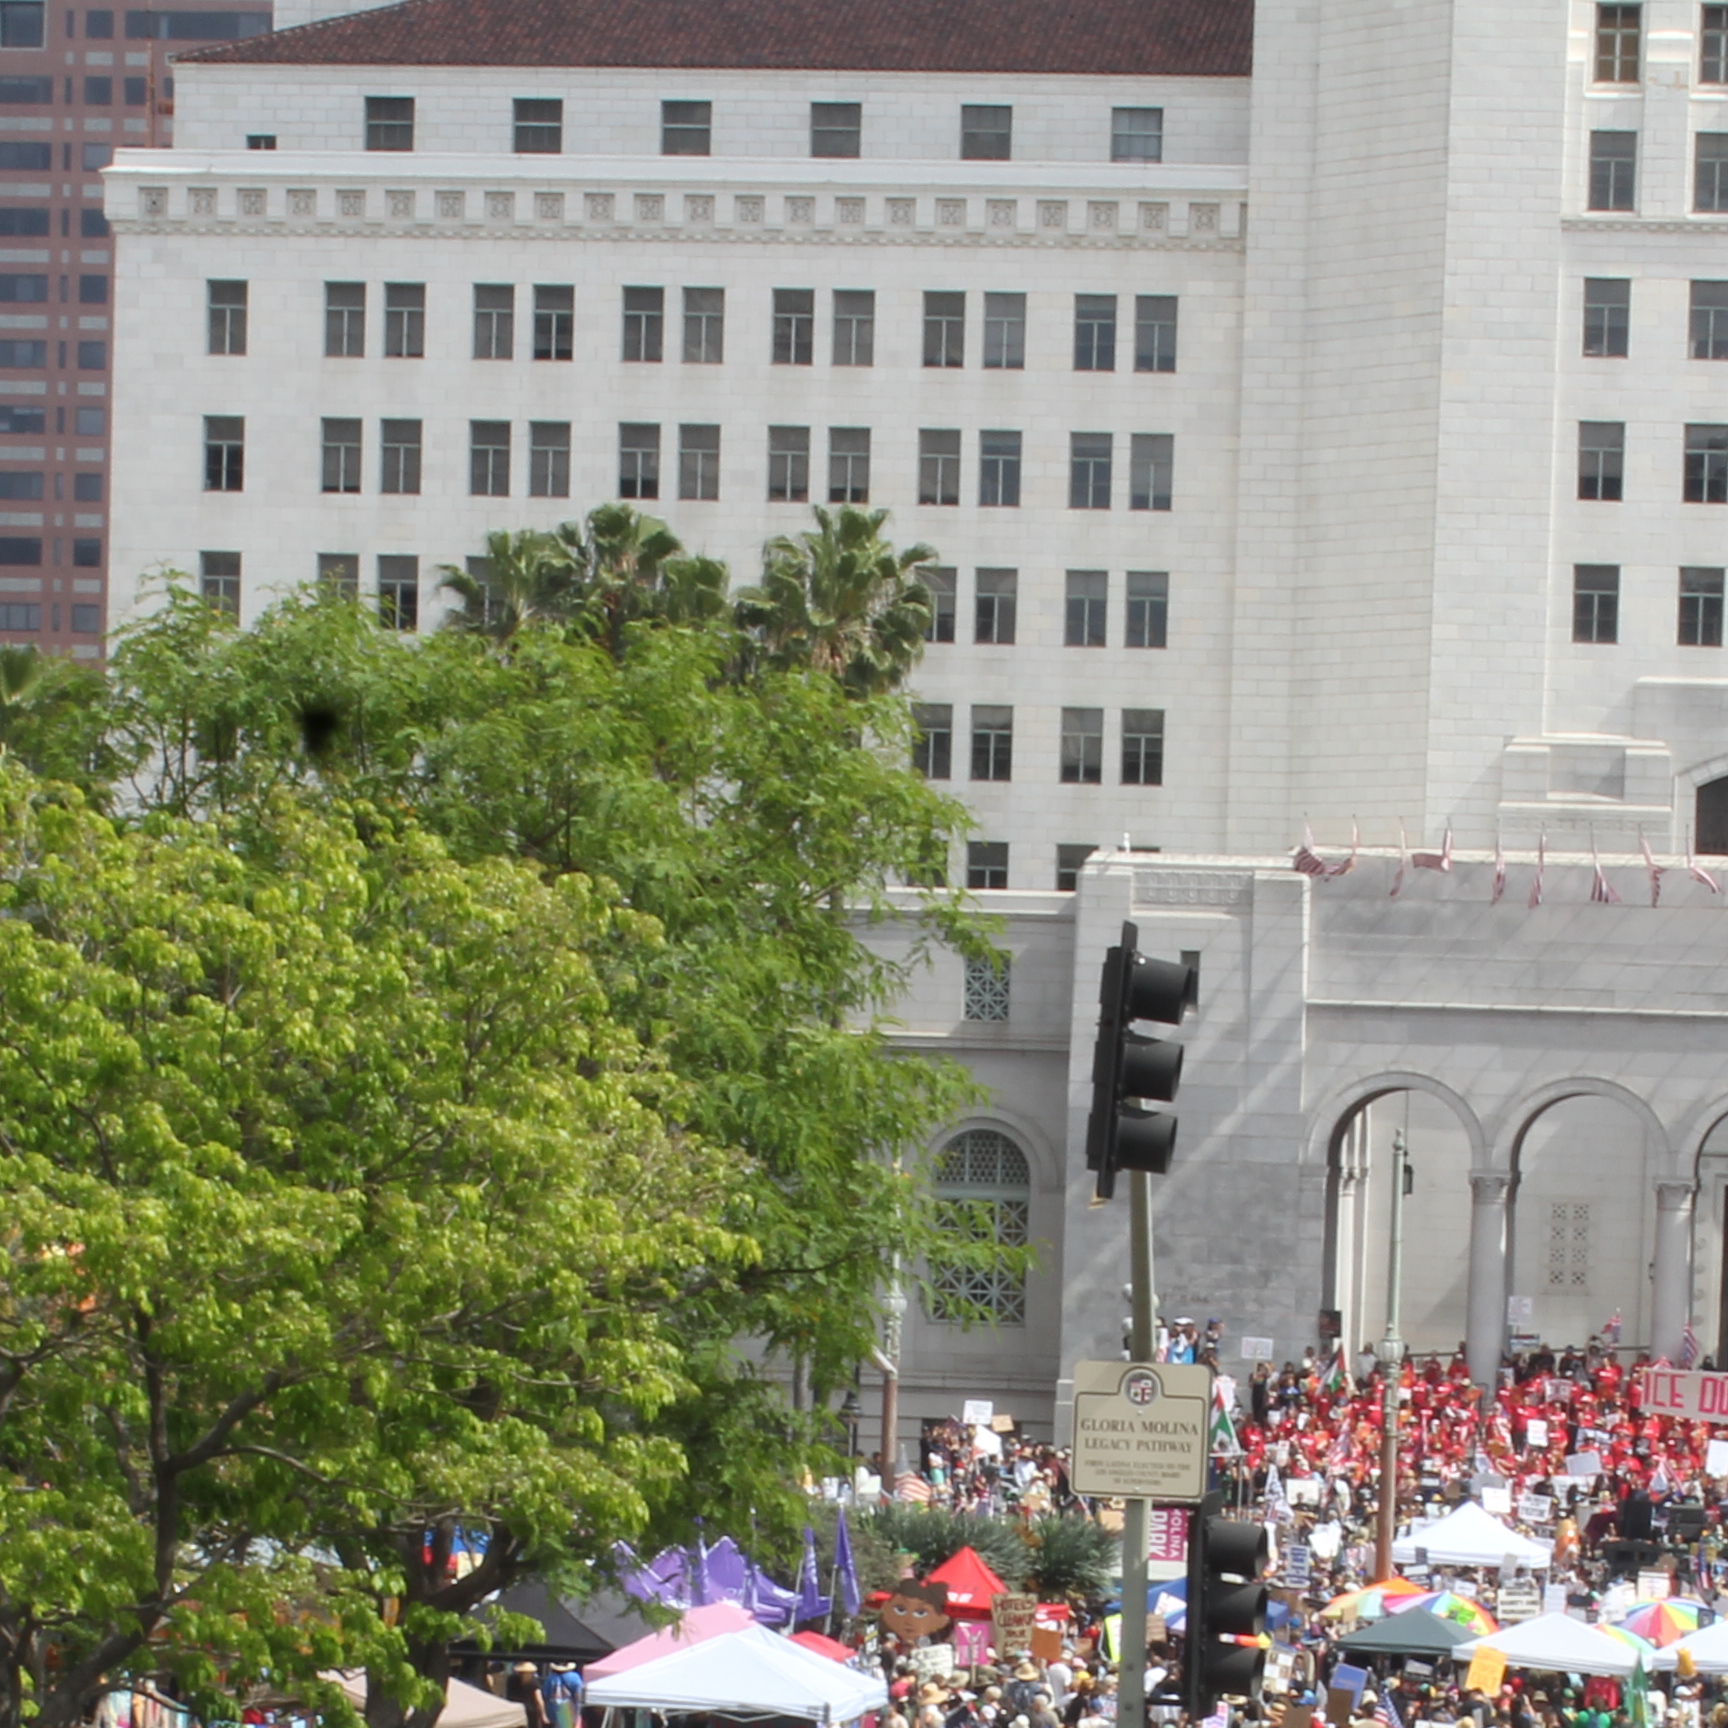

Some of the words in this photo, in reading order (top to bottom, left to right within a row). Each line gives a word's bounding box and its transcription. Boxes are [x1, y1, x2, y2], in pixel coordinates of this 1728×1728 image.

[1645, 1372, 1686, 1408] ICE
[1080, 1418, 1134, 1433] GLORIA
[1142, 1420, 1198, 1435] MOLINA
[1084, 1438, 1132, 1451] LEGACY
[1136, 1440, 1192, 1454] PATHWAY
